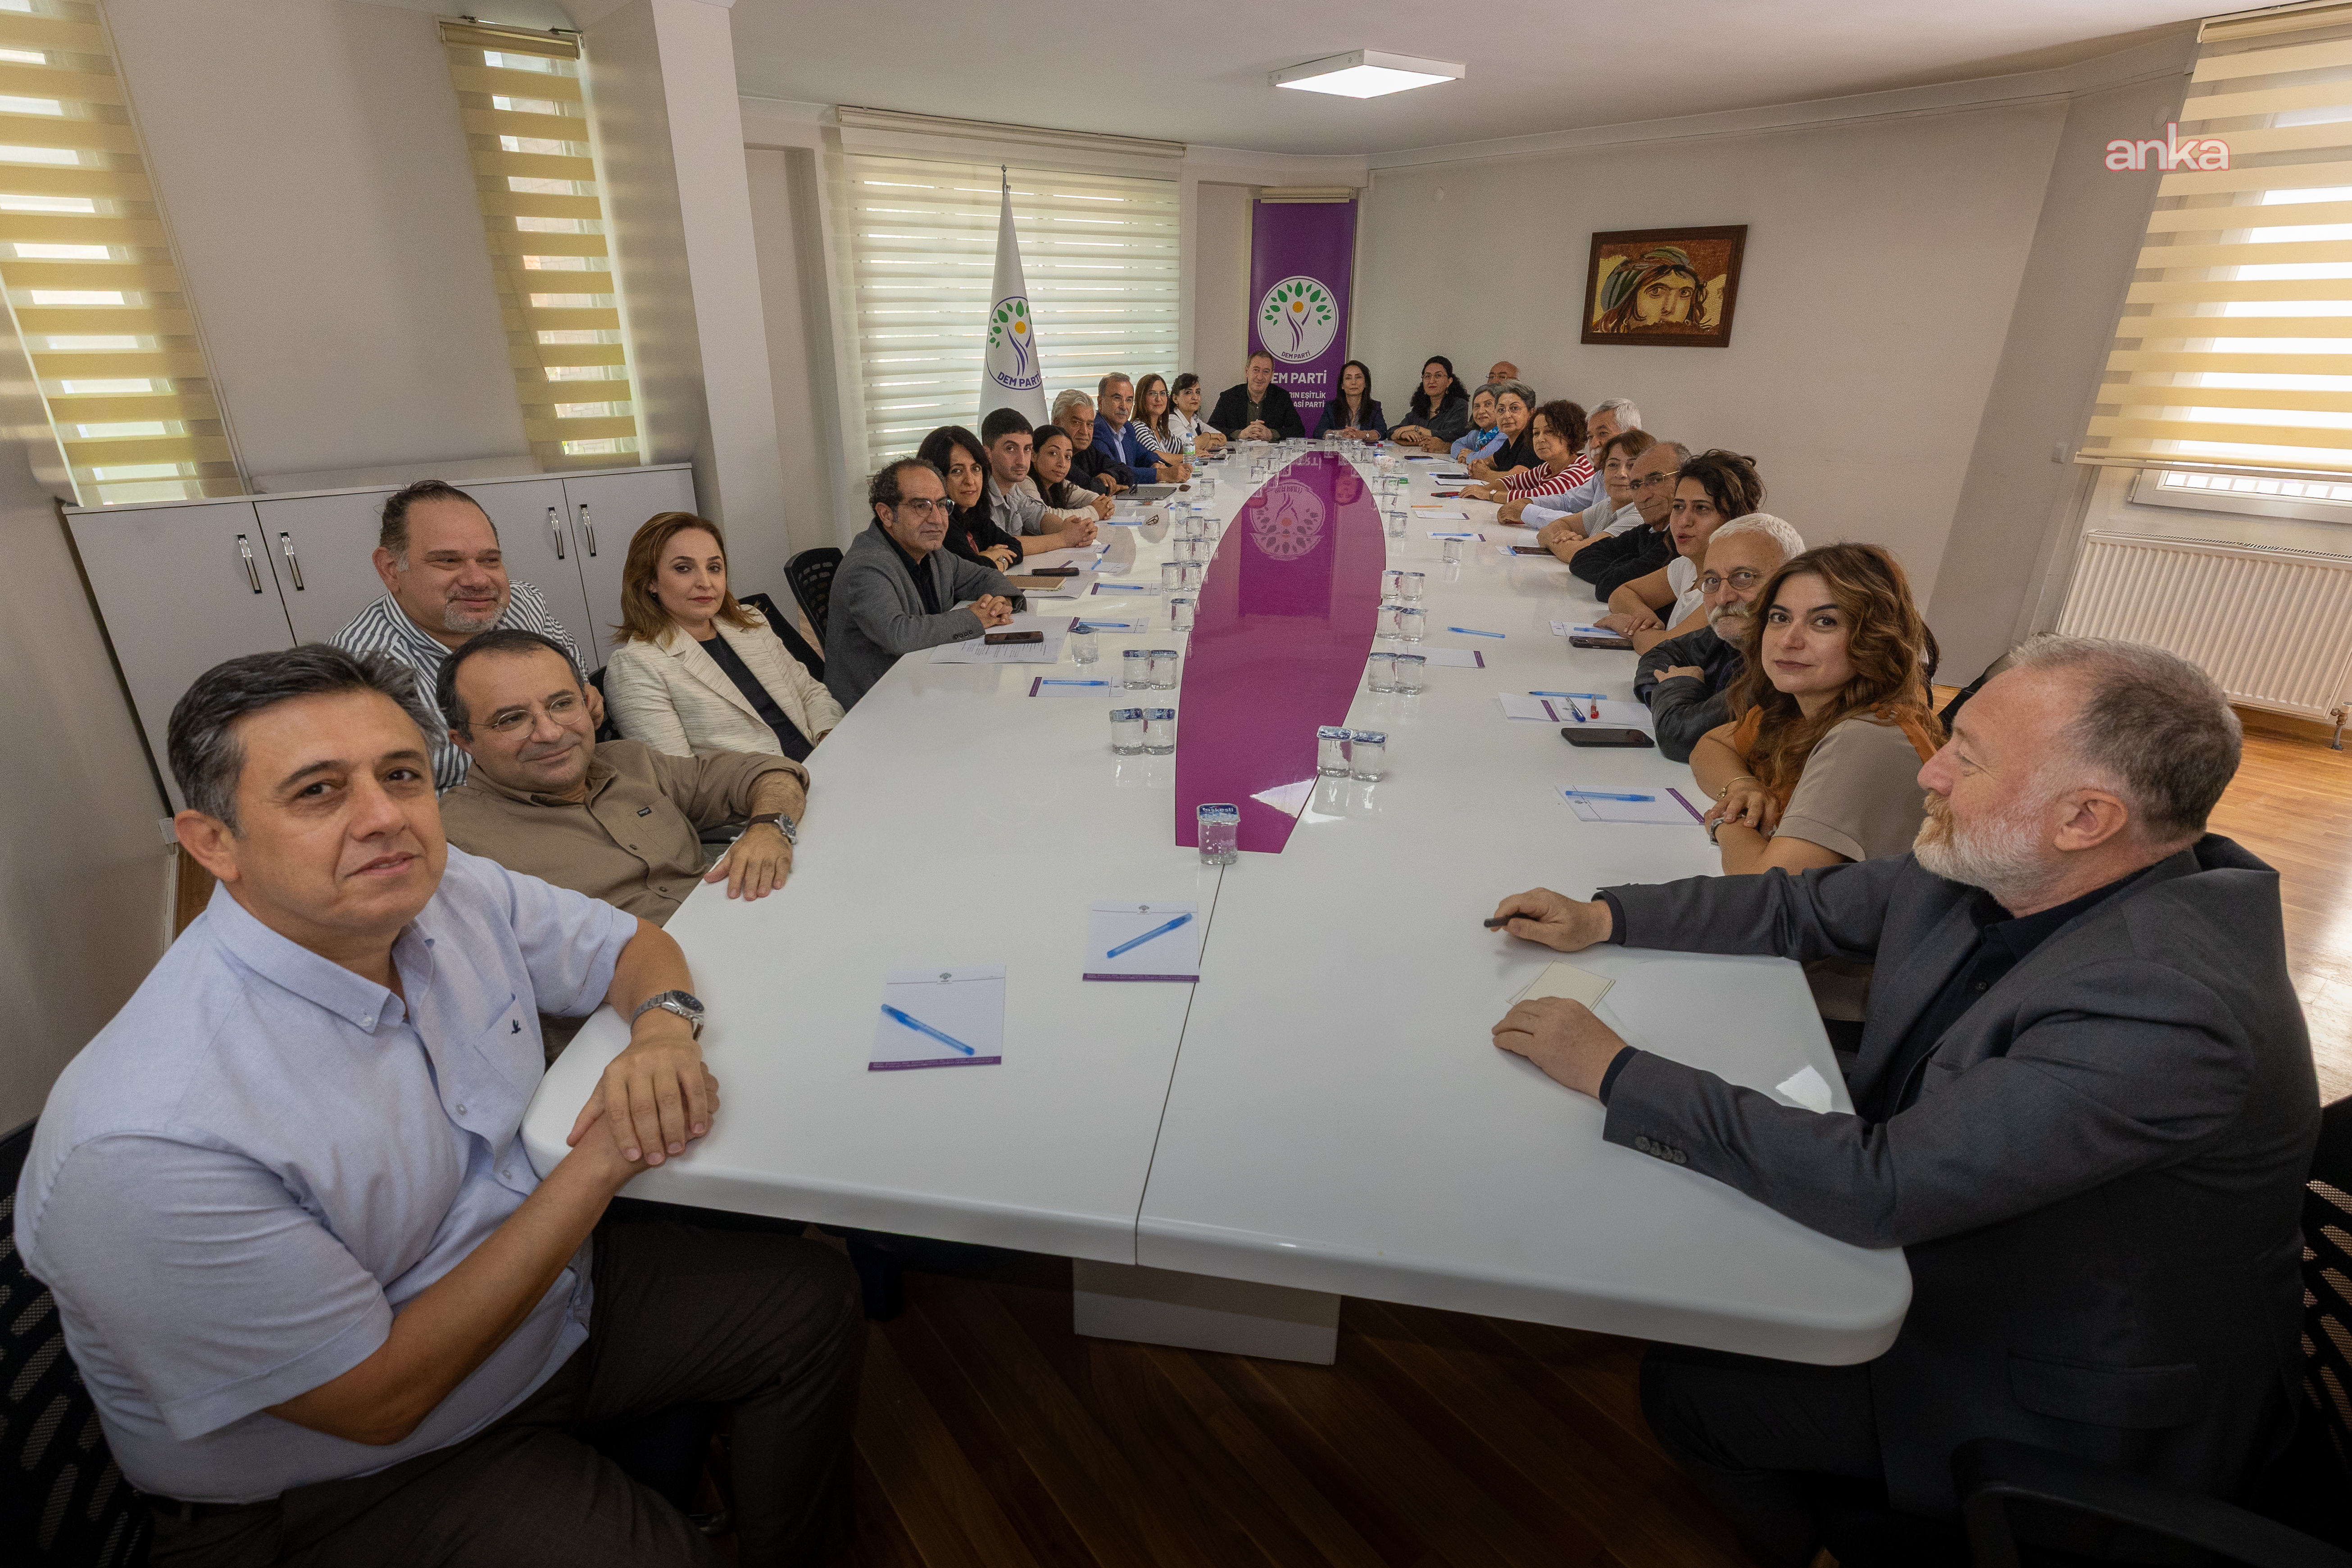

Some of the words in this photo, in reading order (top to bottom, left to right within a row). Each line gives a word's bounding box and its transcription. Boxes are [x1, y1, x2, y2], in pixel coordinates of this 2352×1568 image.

[1294, 350, 1311, 359] PARTİ
[997, 372, 1017, 386] DEM
[1019, 371, 1041, 387] PARTİ
[1271, 373, 1288, 384] EM
[1290, 369, 1327, 384] PARTİ
[1301, 391, 1326, 400] EŞİTLİK
[1294, 400, 1304, 408] ASİ
